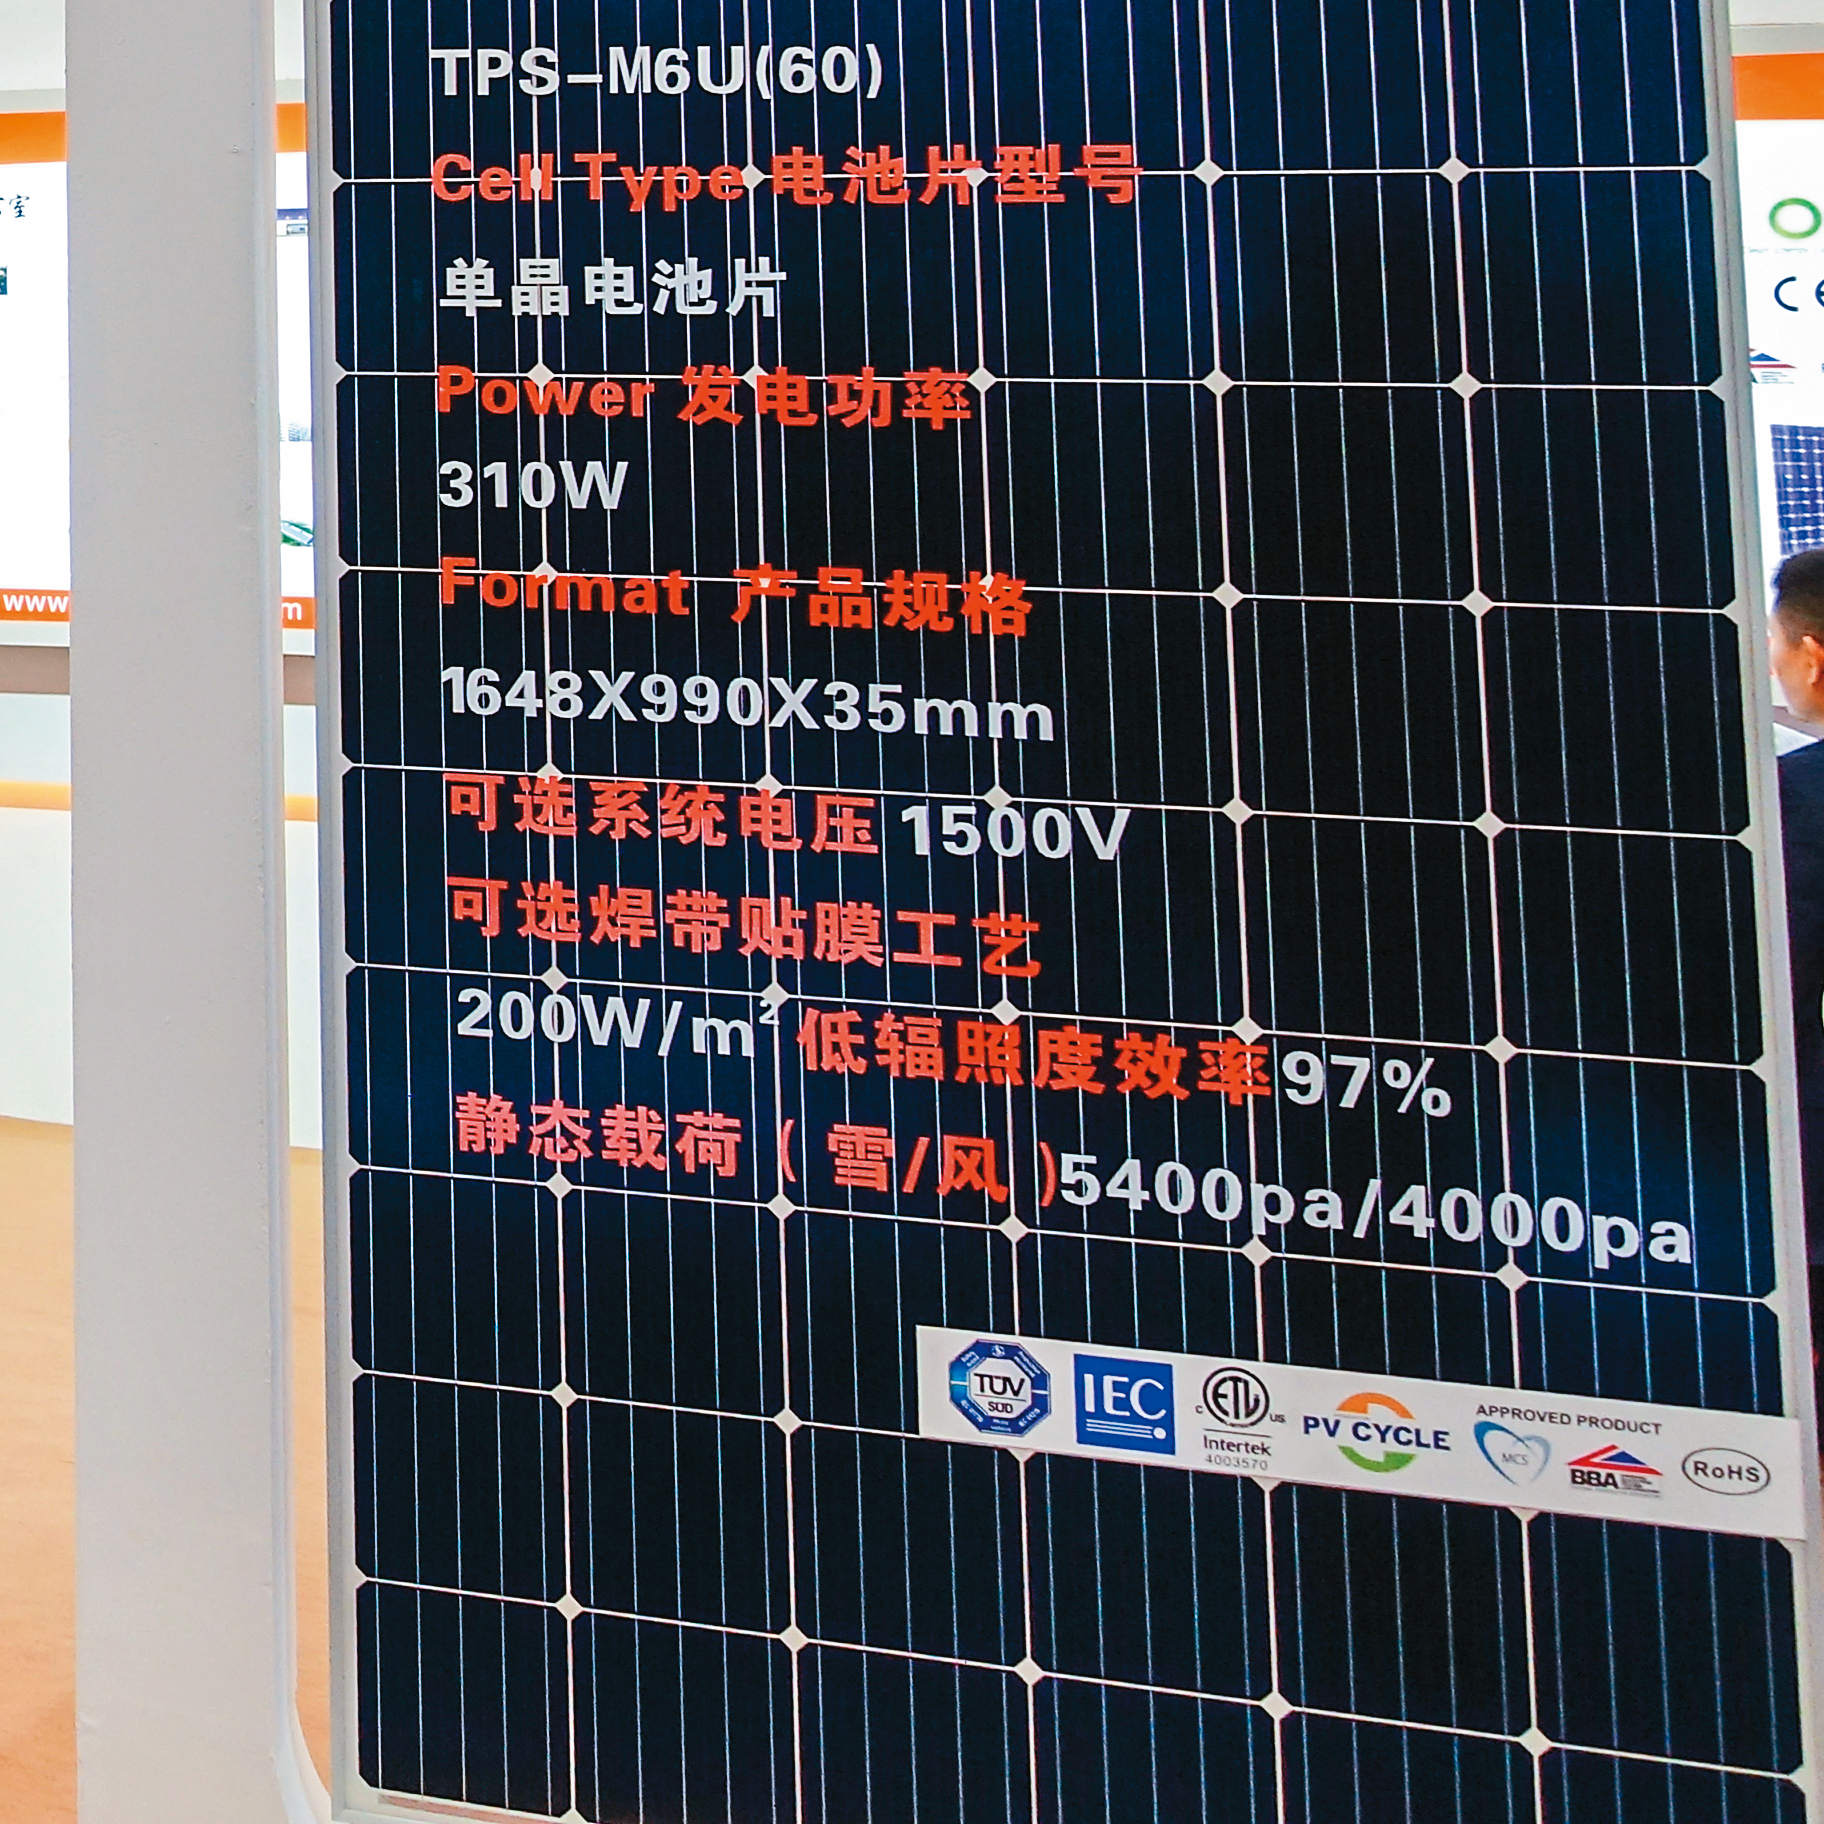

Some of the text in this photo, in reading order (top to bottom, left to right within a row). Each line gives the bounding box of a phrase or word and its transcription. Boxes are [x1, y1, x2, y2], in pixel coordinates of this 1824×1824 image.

[430, 42, 884, 102] TPS-M6U(60)
[432, 145, 1143, 214] Cell Type 电池片型号
[439, 257, 787, 319] 单晶电池片
[436, 365, 973, 430] Power 发电功率
[438, 458, 629, 512] 310W
[439, 558, 1034, 640] Format 产品规格
[441, 665, 1055, 743] 1648X990X35mm
[444, 773, 1132, 864] 可选系统电压 1500V
[446, 875, 1043, 981] 可选焊带贴膜工艺
[1280, 1048, 1453, 1120] 97%
[1059, 1151, 1693, 1273] 5400pa/4000pa
[1083, 1373, 1167, 1420] IEC
[1475, 1404, 1663, 1436] APPROVED PRODUCT
[1203, 1434, 1272, 1457] Intertek
[1204, 1454, 1269, 1471] 4003570
[1303, 1415, 1451, 1451] PV CYCLE
[1501, 1451, 1529, 1467] MCS
[1570, 1468, 1619, 1490] BBA
[1693, 1461, 1760, 1484] RoHS
